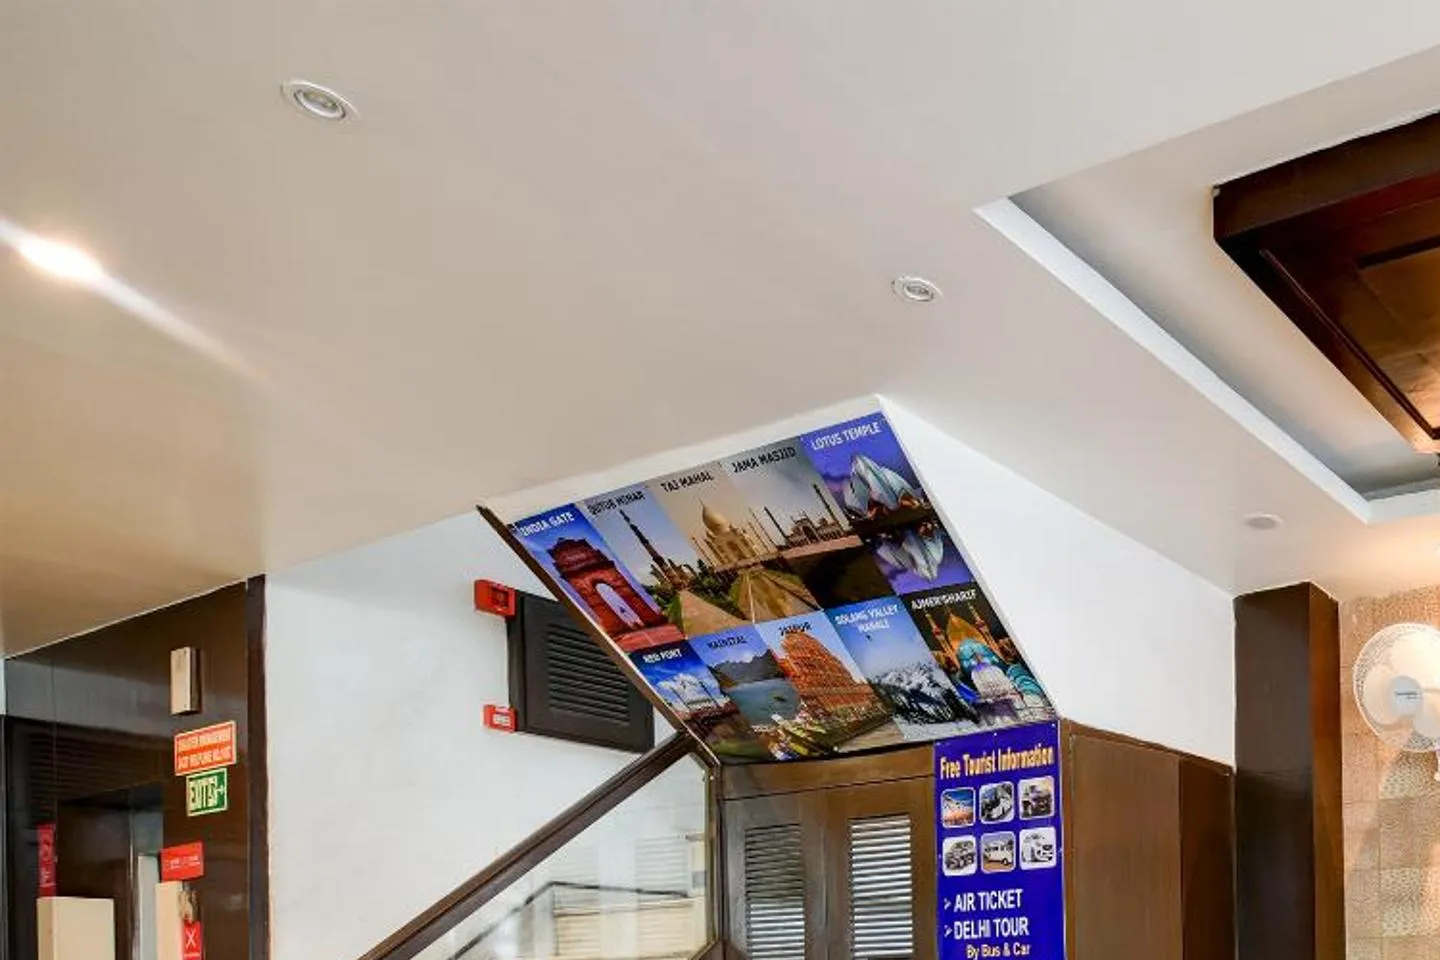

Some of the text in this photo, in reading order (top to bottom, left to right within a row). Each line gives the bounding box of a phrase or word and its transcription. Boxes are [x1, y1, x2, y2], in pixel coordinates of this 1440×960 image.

[811, 422, 882, 450] LOTUS TEMPLE
[760, 446, 796, 465] MASJID
[549, 511, 575, 529] GATE
[941, 746, 1054, 780] Free Tourist Information
[954, 888, 1023, 912] AIR TICKET
[954, 916, 1029, 940] DELHI TOUR
[967, 942, 1031, 960] By Bus & Car
